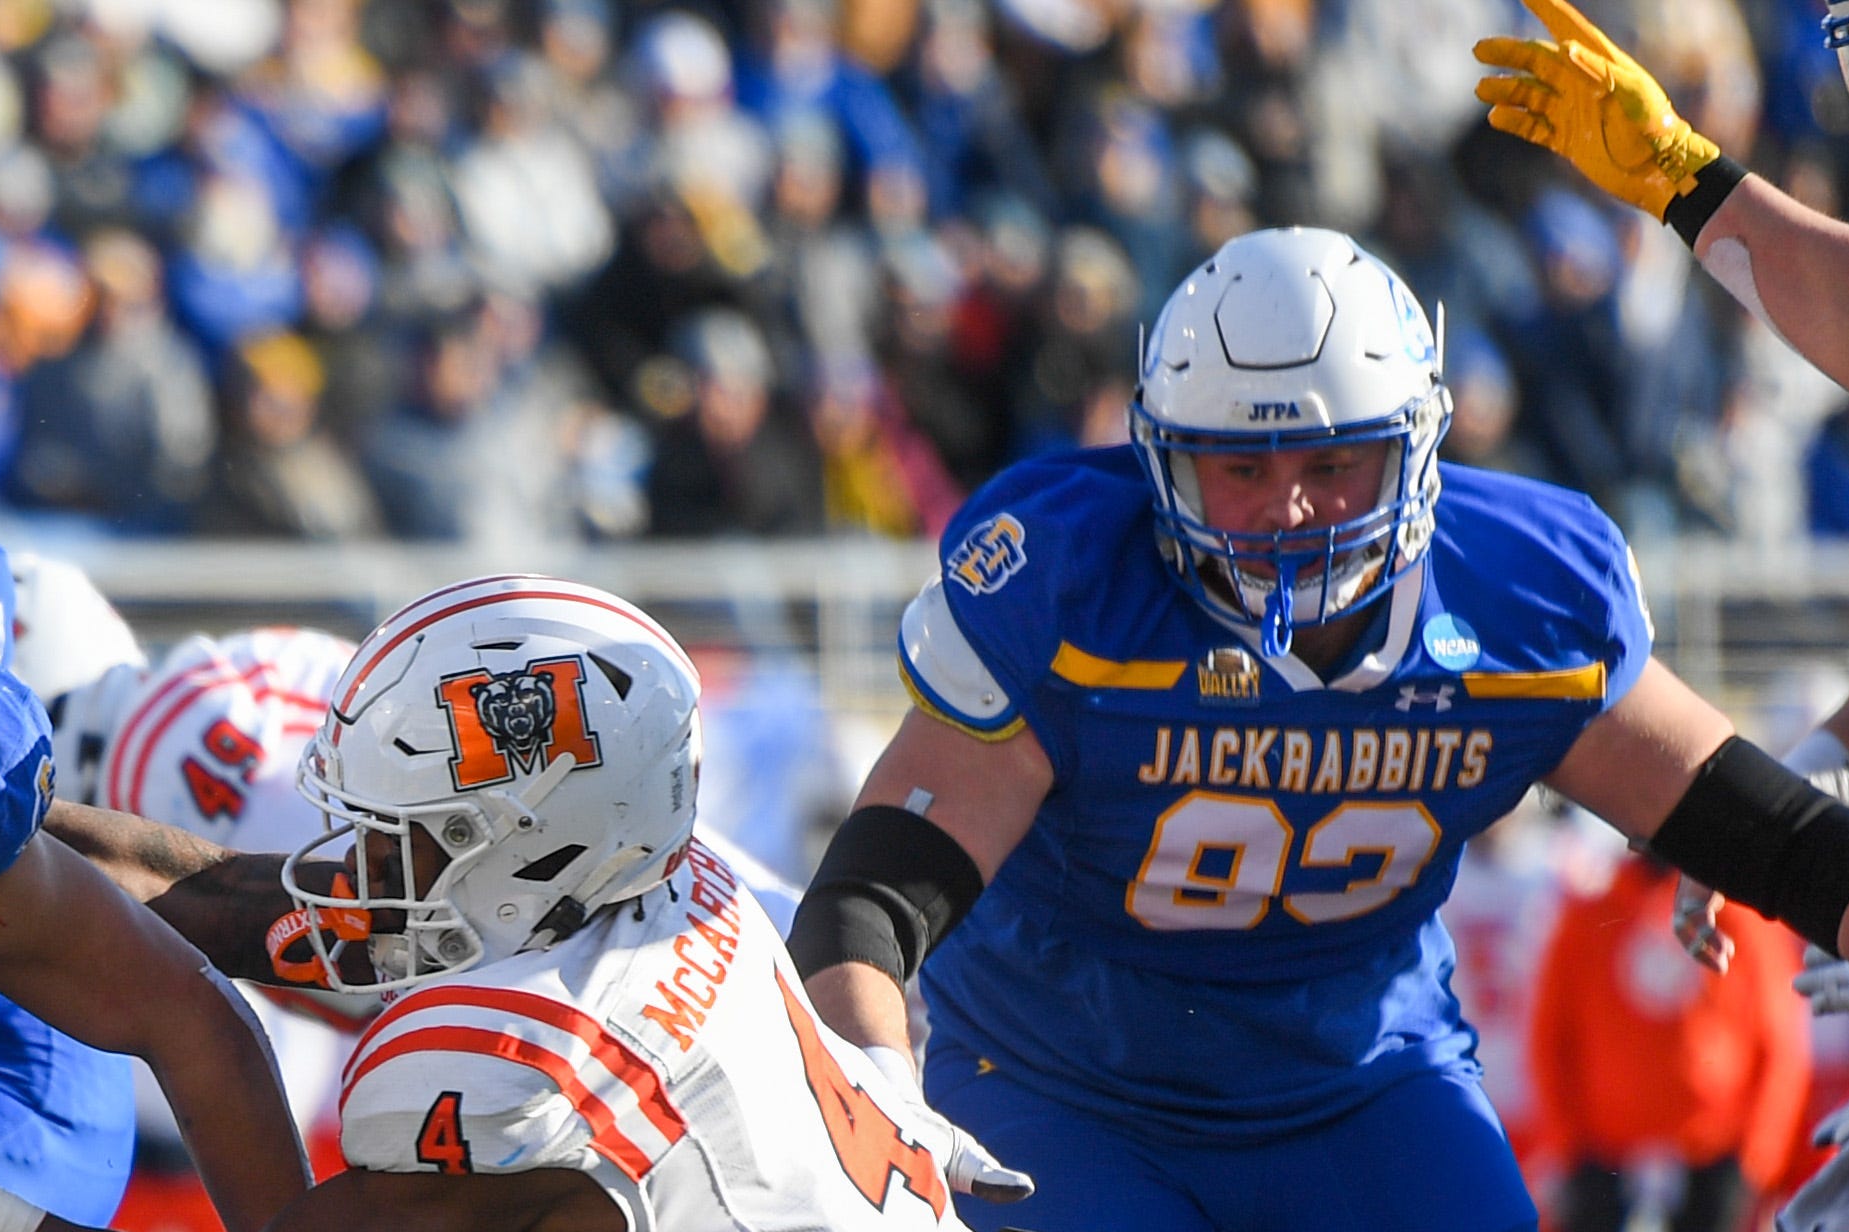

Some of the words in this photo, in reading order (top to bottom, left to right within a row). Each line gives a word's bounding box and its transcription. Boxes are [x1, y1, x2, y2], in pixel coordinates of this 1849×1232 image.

[1248, 401, 1301, 422] JFPA
[179, 716, 267, 824] 49
[1137, 726, 1493, 794] JACKRABBITS
[414, 1090, 475, 1177] 4
[772, 956, 948, 1228] 4
